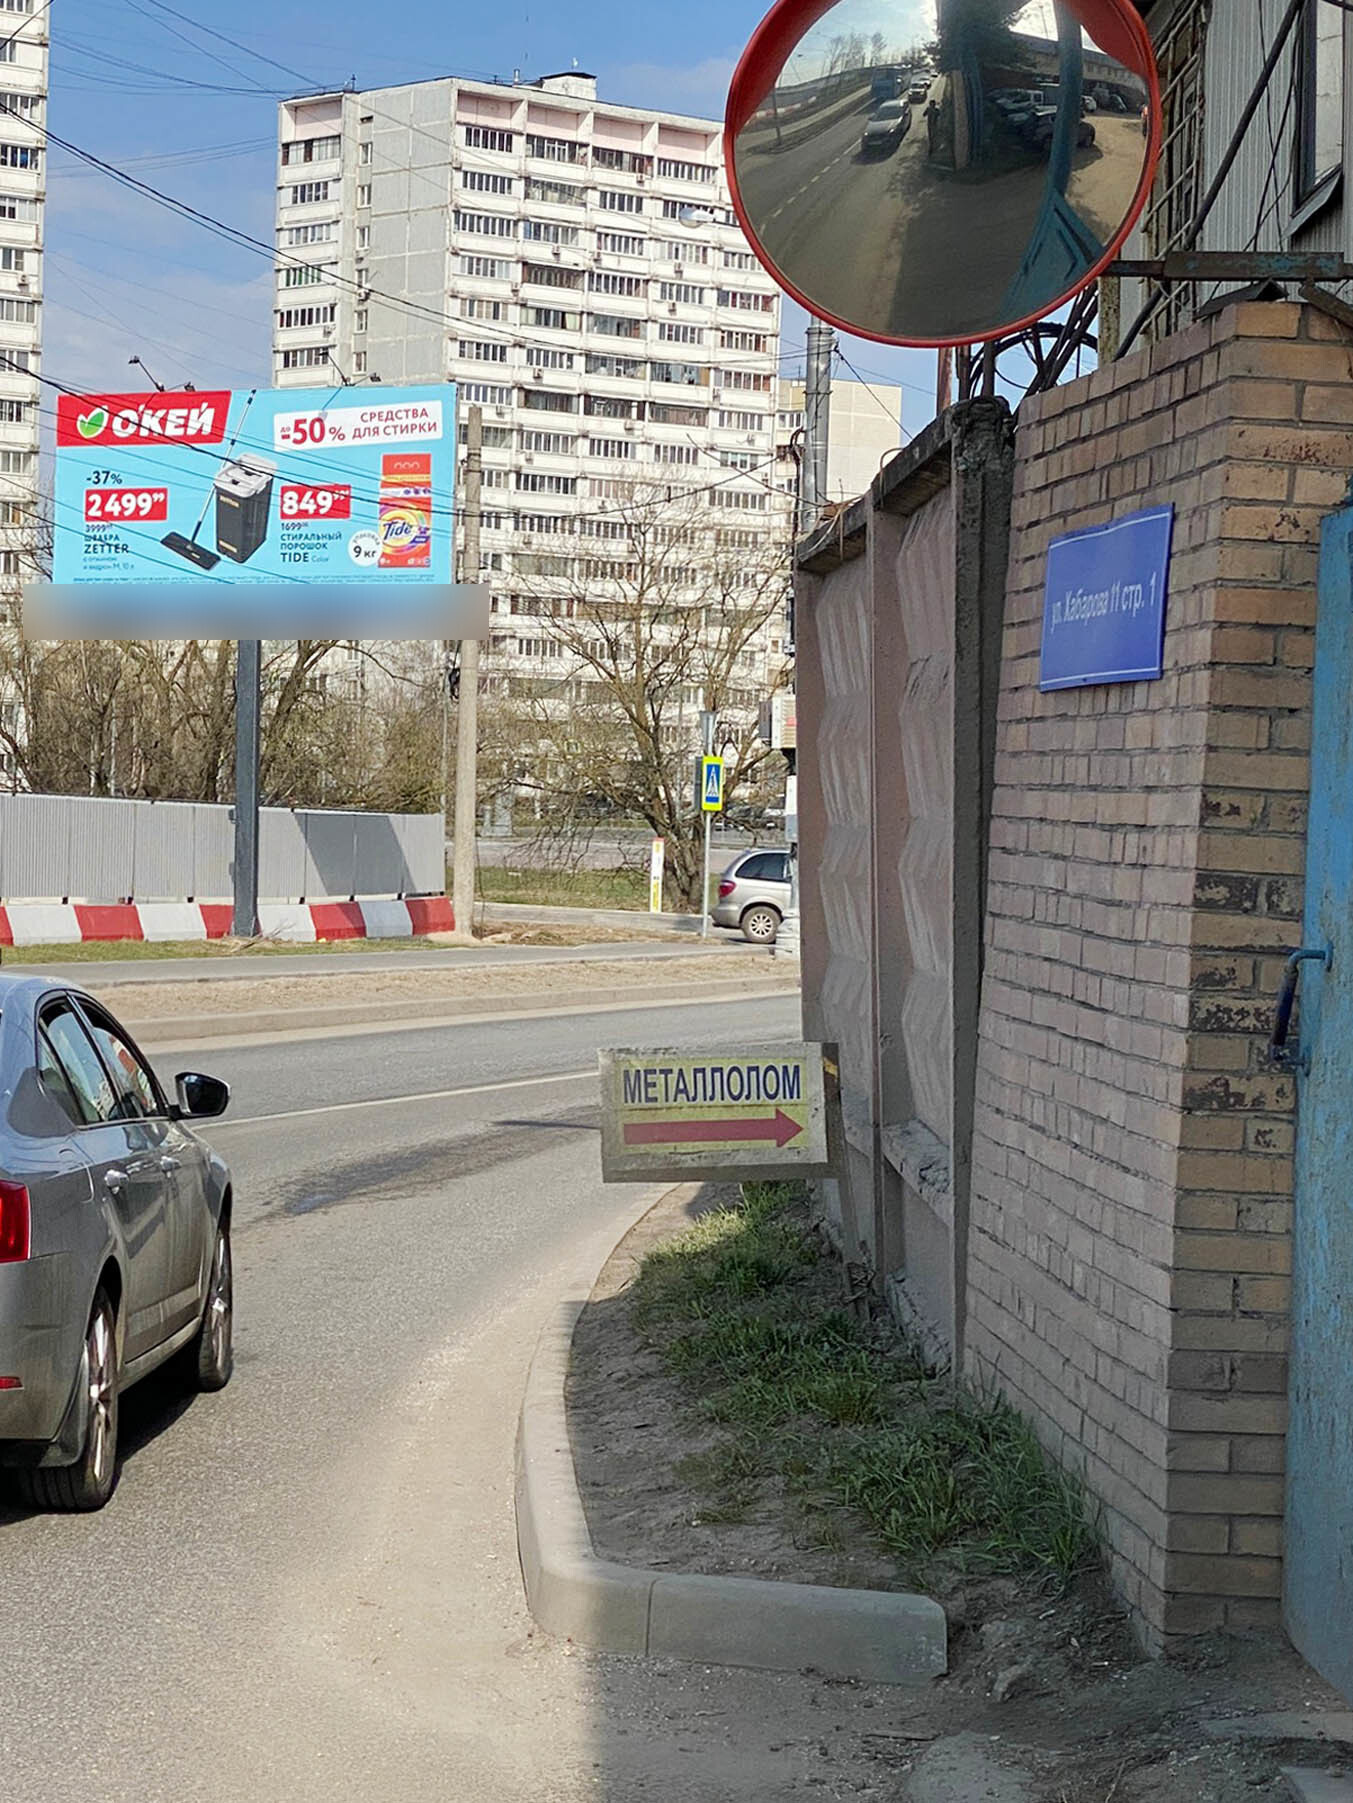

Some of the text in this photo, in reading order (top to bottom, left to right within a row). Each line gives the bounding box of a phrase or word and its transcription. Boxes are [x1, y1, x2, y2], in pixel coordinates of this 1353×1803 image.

[360, 408, 429, 423] СРЕДСТВА
[352, 422, 437, 440] ДЛЯ СТИРКИ
[86, 470, 123, 485] -37%
[280, 532, 343, 542] СТИРАЛЬНЫЙ
[383, 521, 413, 541] Tide
[84, 544, 130, 554] ZETTER
[280, 552, 309, 563] TIDE
[1122, 584, 1145, 618] стр.
[1150, 572, 1157, 607] 1
[623, 1064, 801, 1103] МЕТАЛЛОЛОМ
